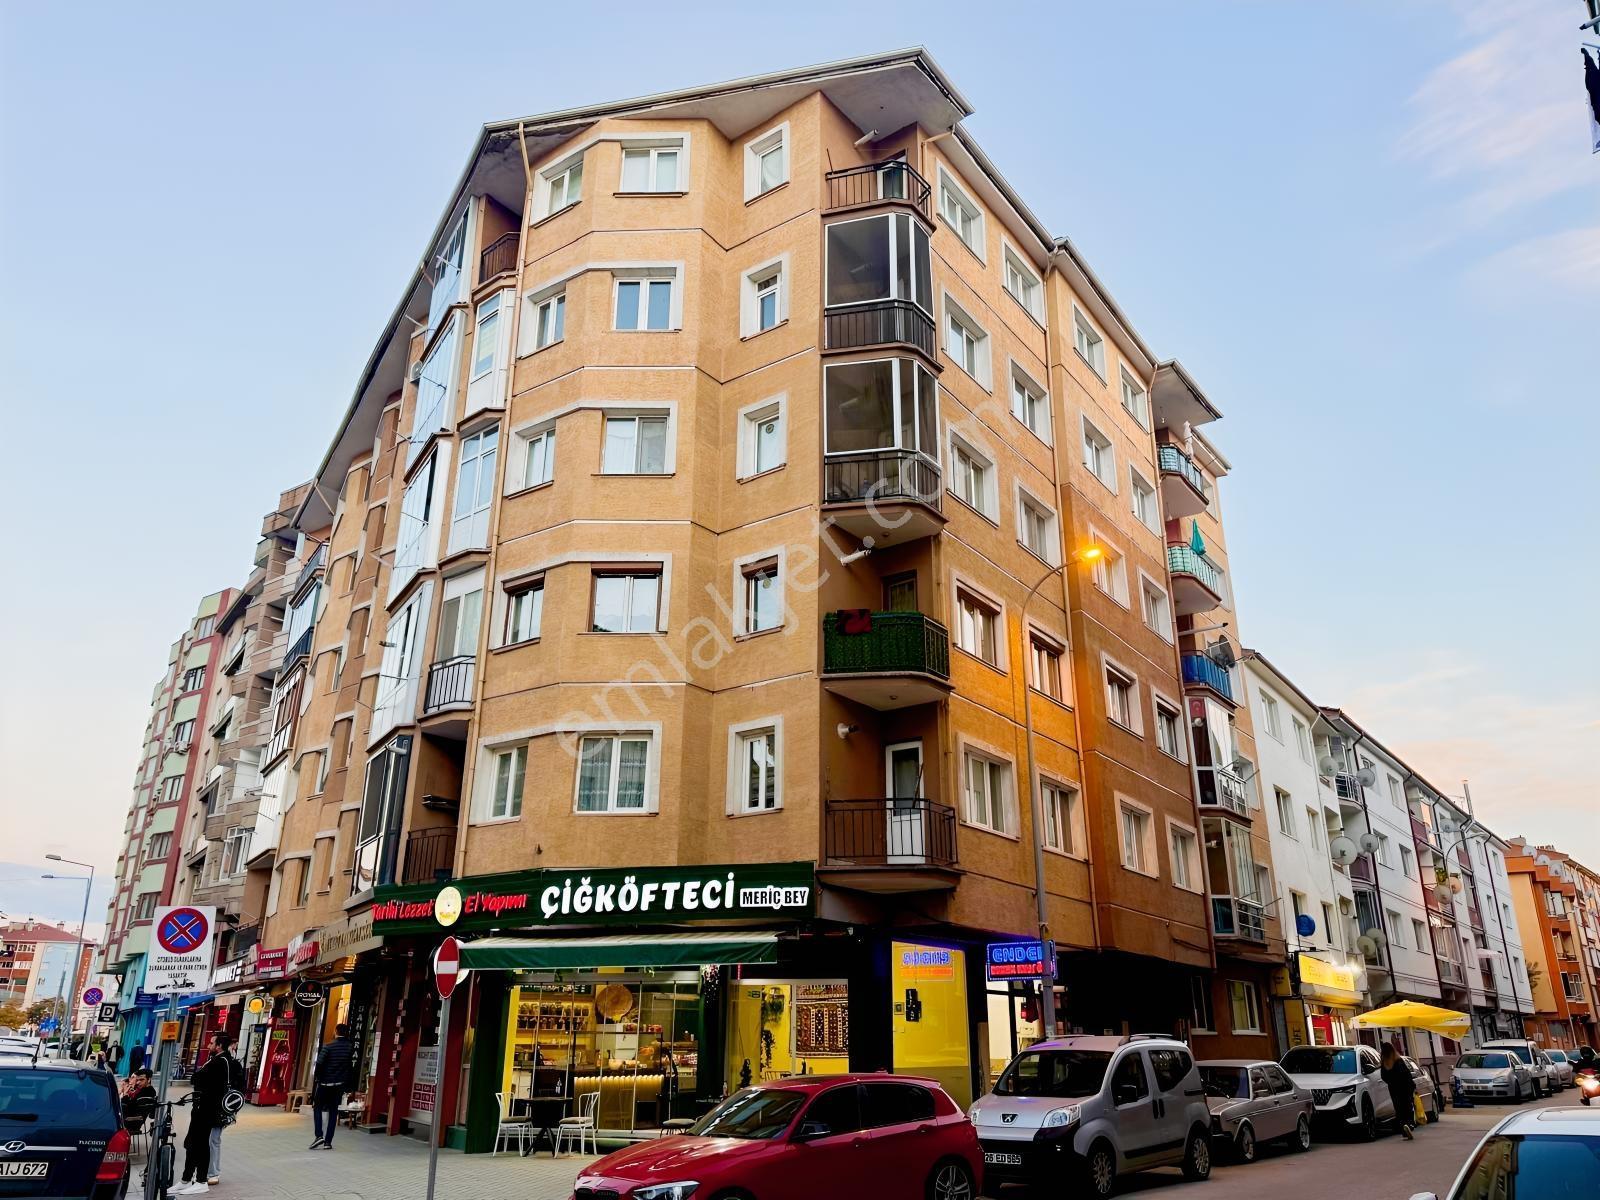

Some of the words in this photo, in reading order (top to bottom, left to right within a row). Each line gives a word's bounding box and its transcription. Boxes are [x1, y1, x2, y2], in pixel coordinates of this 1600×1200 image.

[464, 892, 481, 913] El
[481, 893, 528, 917] Yapımı
[540, 871, 735, 919] ÇİĞKÖFTECİ
[742, 887, 781, 908] MERİÇ
[784, 890, 807, 905] BEY
[371, 900, 398, 921] Tarihi
[399, 899, 434, 919] Lezzet
[23, 1163, 47, 1176] 672
